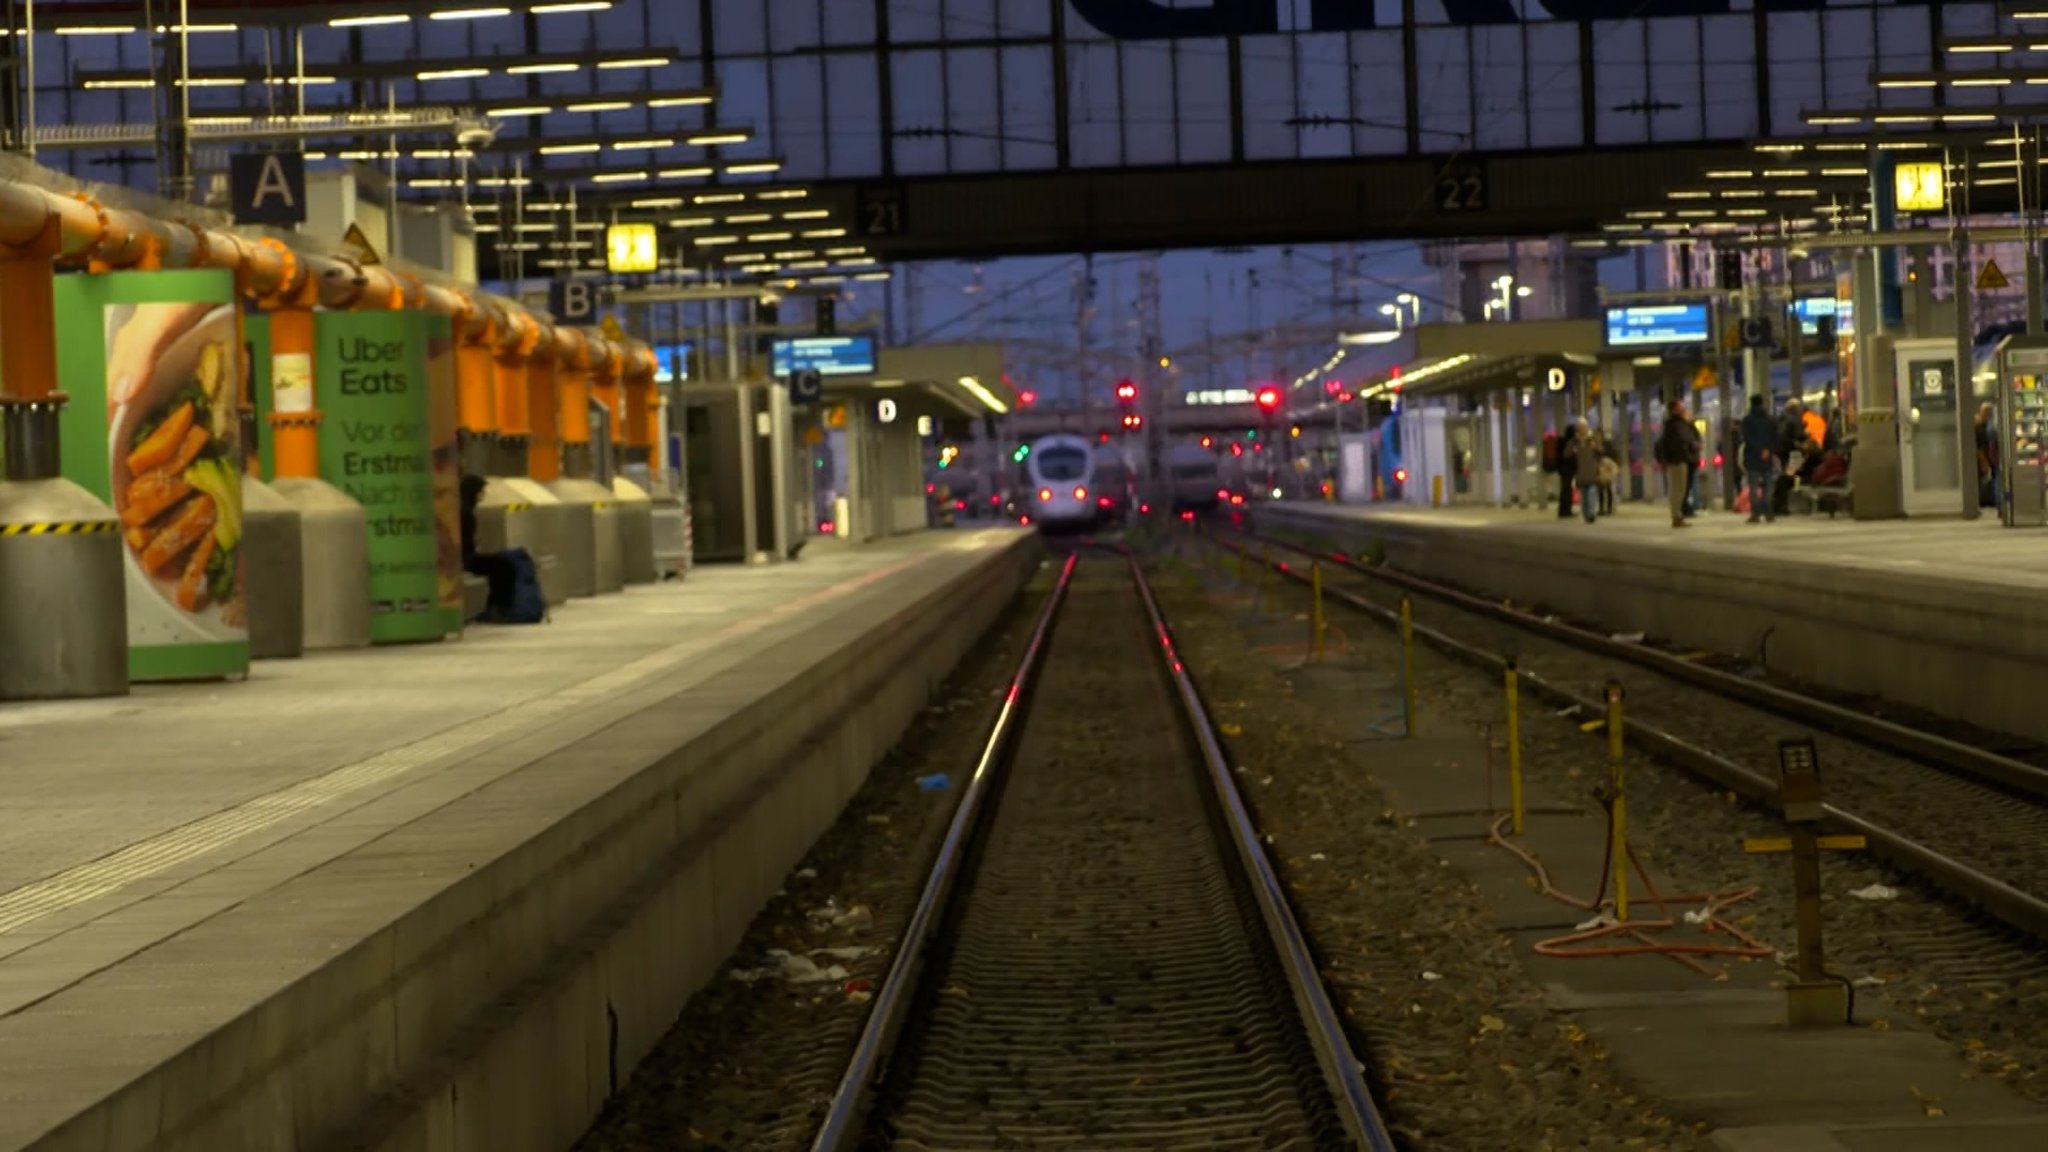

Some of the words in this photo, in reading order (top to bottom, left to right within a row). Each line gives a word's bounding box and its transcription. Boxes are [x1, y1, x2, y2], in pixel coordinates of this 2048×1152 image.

[252, 154, 295, 208] A
[1441, 177, 1482, 208] 22
[866, 202, 899, 233] 21
[565, 281, 590, 316] B
[1742, 317, 1763, 344] C
[338, 337, 404, 362] Uber
[340, 369, 408, 395] Eats
[797, 369, 819, 396] C
[1548, 367, 1566, 391] D
[878, 398, 897, 424] D
